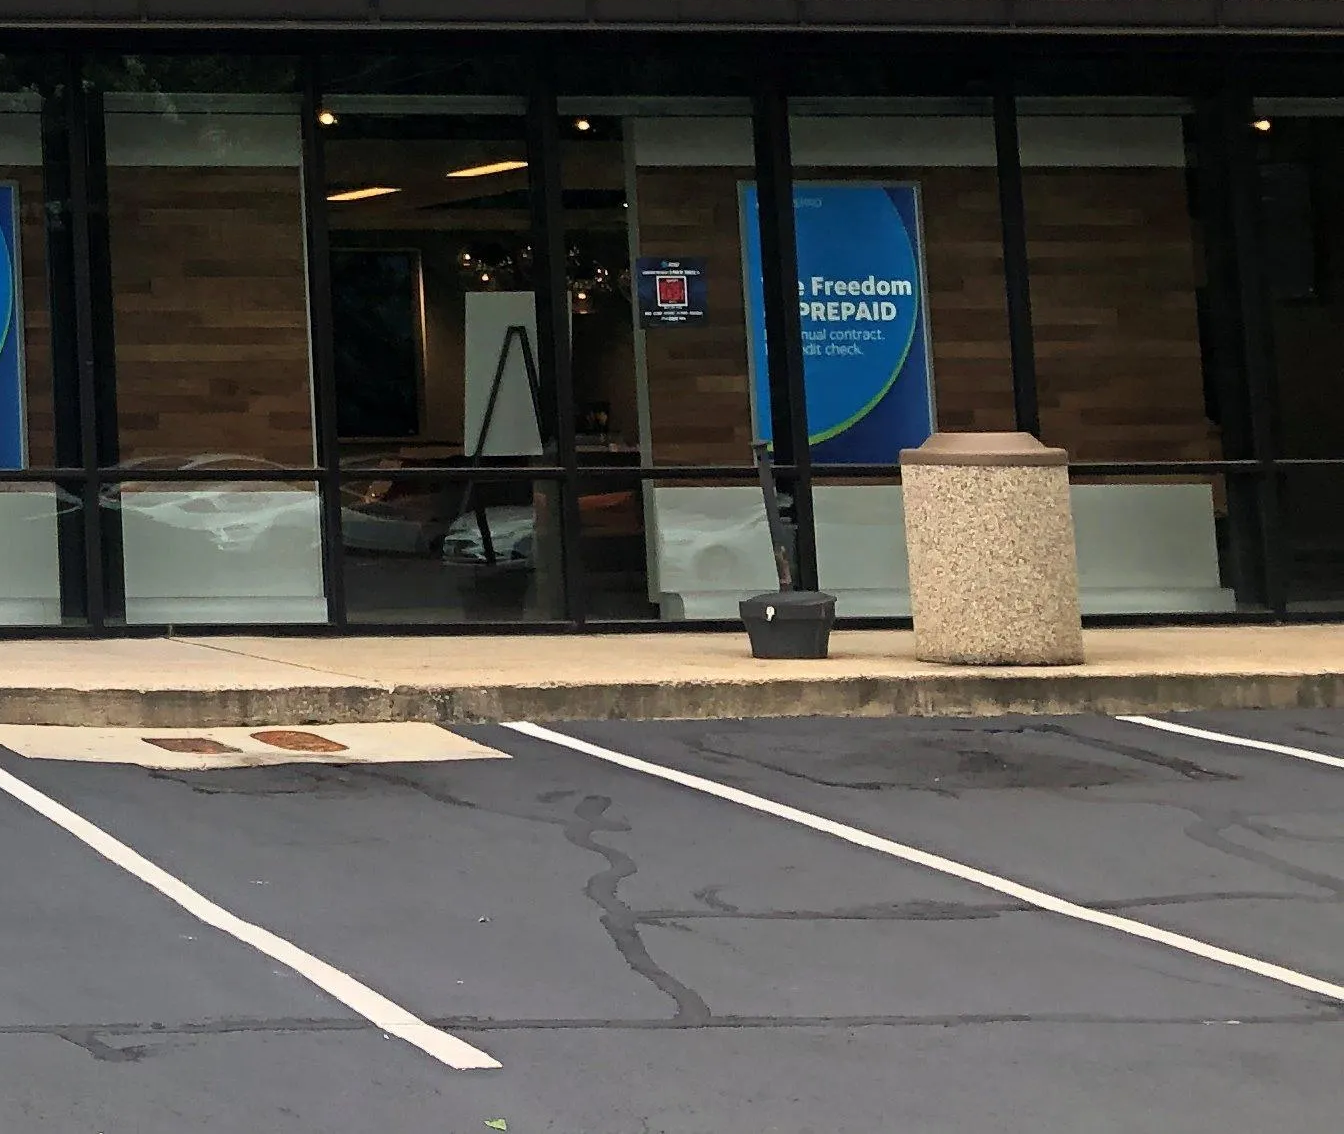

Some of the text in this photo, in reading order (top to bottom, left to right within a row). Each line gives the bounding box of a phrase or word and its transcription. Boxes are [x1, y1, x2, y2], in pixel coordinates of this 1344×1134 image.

[812, 275, 912, 296] Freedom
[801, 328, 886, 341] nual contract.
[825, 343, 864, 356] check.
